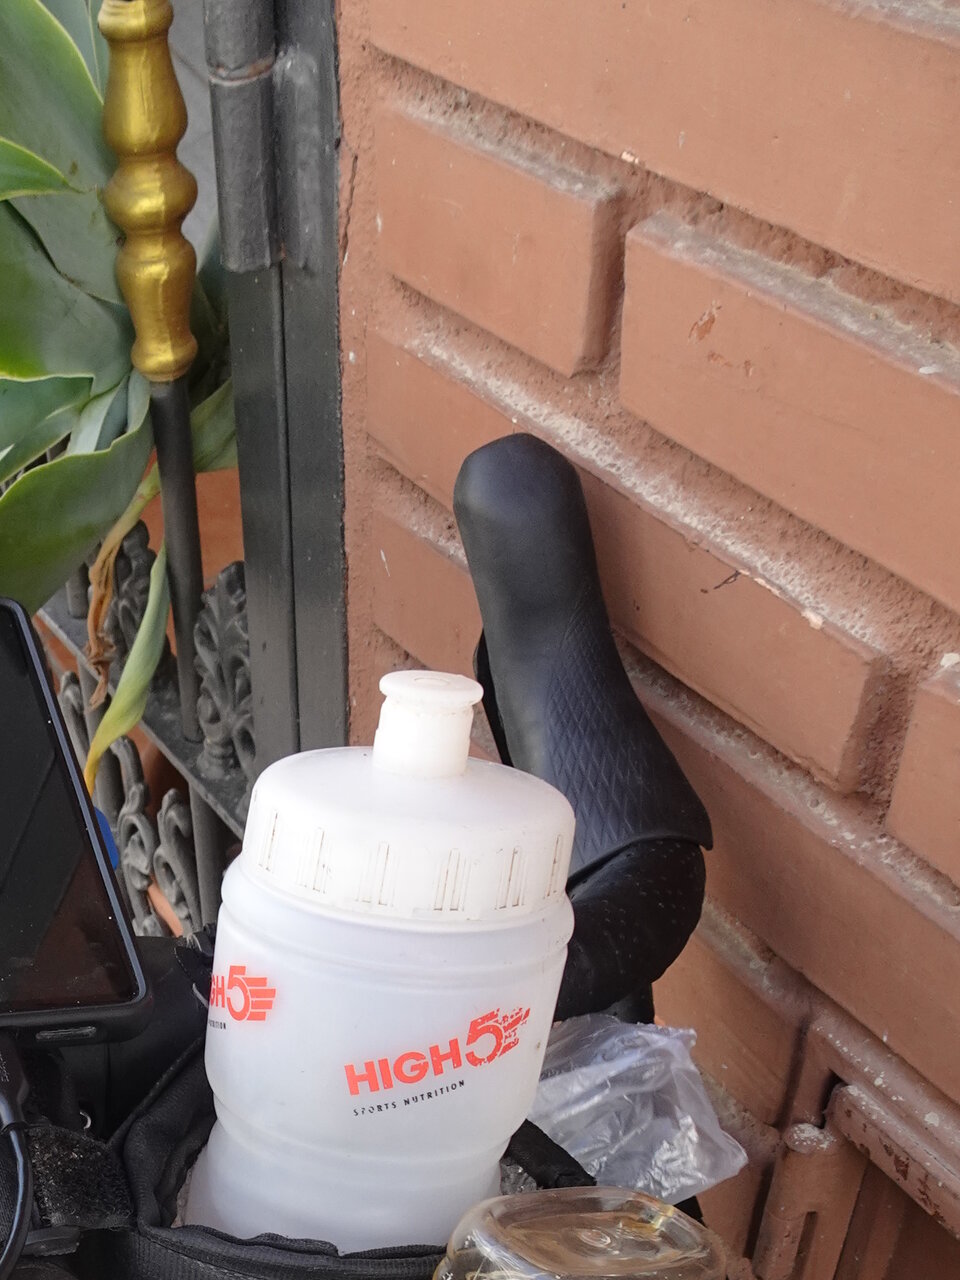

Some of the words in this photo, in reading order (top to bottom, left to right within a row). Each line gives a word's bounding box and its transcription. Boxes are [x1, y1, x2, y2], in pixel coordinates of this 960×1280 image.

[210, 965, 252, 1021] GH5
[344, 1008, 506, 1096] HIGH5
[353, 1100, 397, 1117] SPORTS
[403, 1080, 466, 1106] NUTRITION
